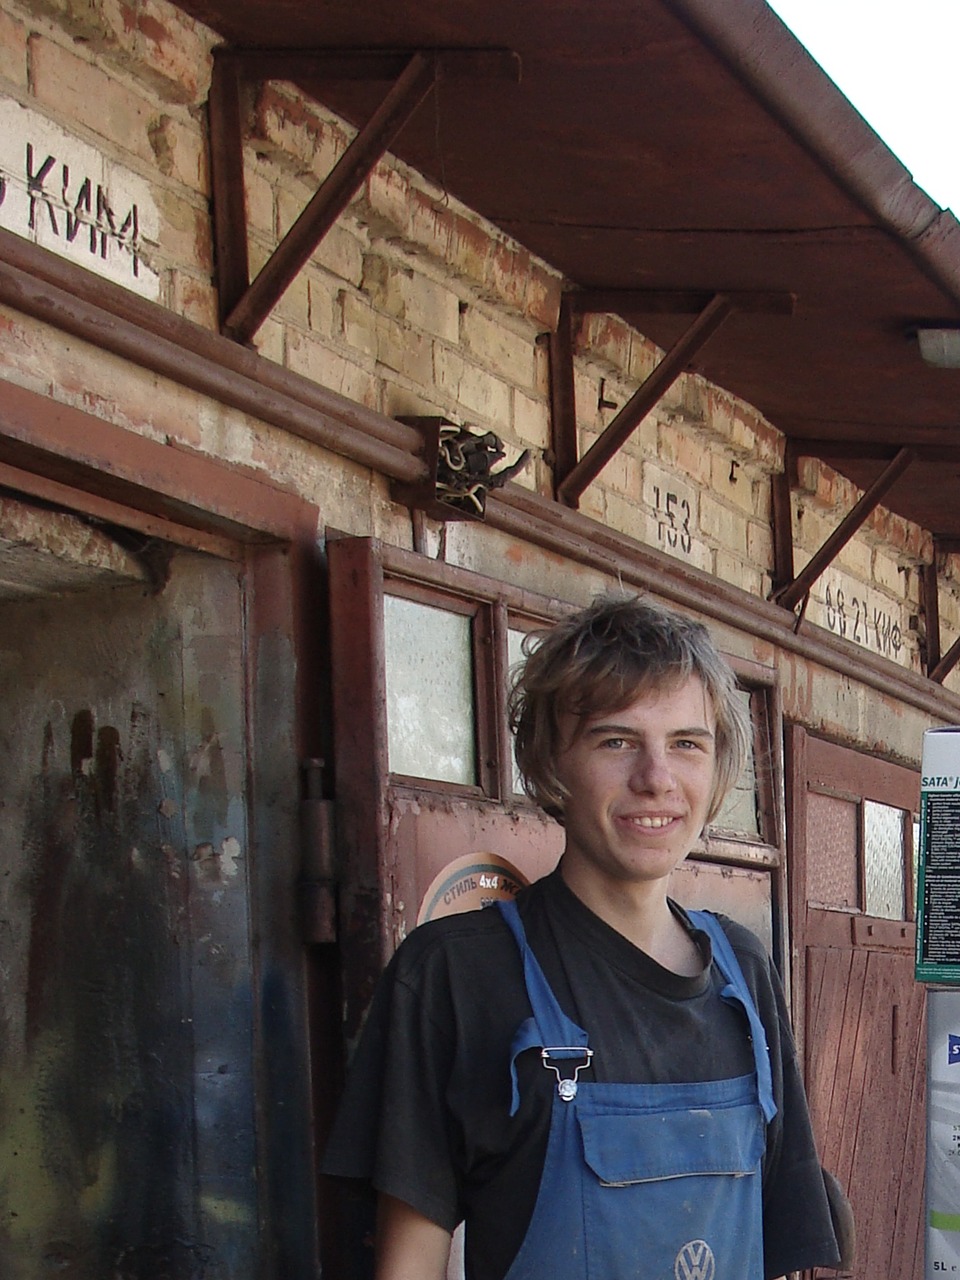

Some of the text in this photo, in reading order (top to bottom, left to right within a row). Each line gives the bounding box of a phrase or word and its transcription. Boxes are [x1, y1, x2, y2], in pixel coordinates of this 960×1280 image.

[26, 142, 140, 278] КИМ
[653, 485, 693, 554] 153
[873, 607, 902, 660] КИФ
[443, 877, 478, 905] СТИЛЬ
[933, 1261, 947, 1271] 5L
